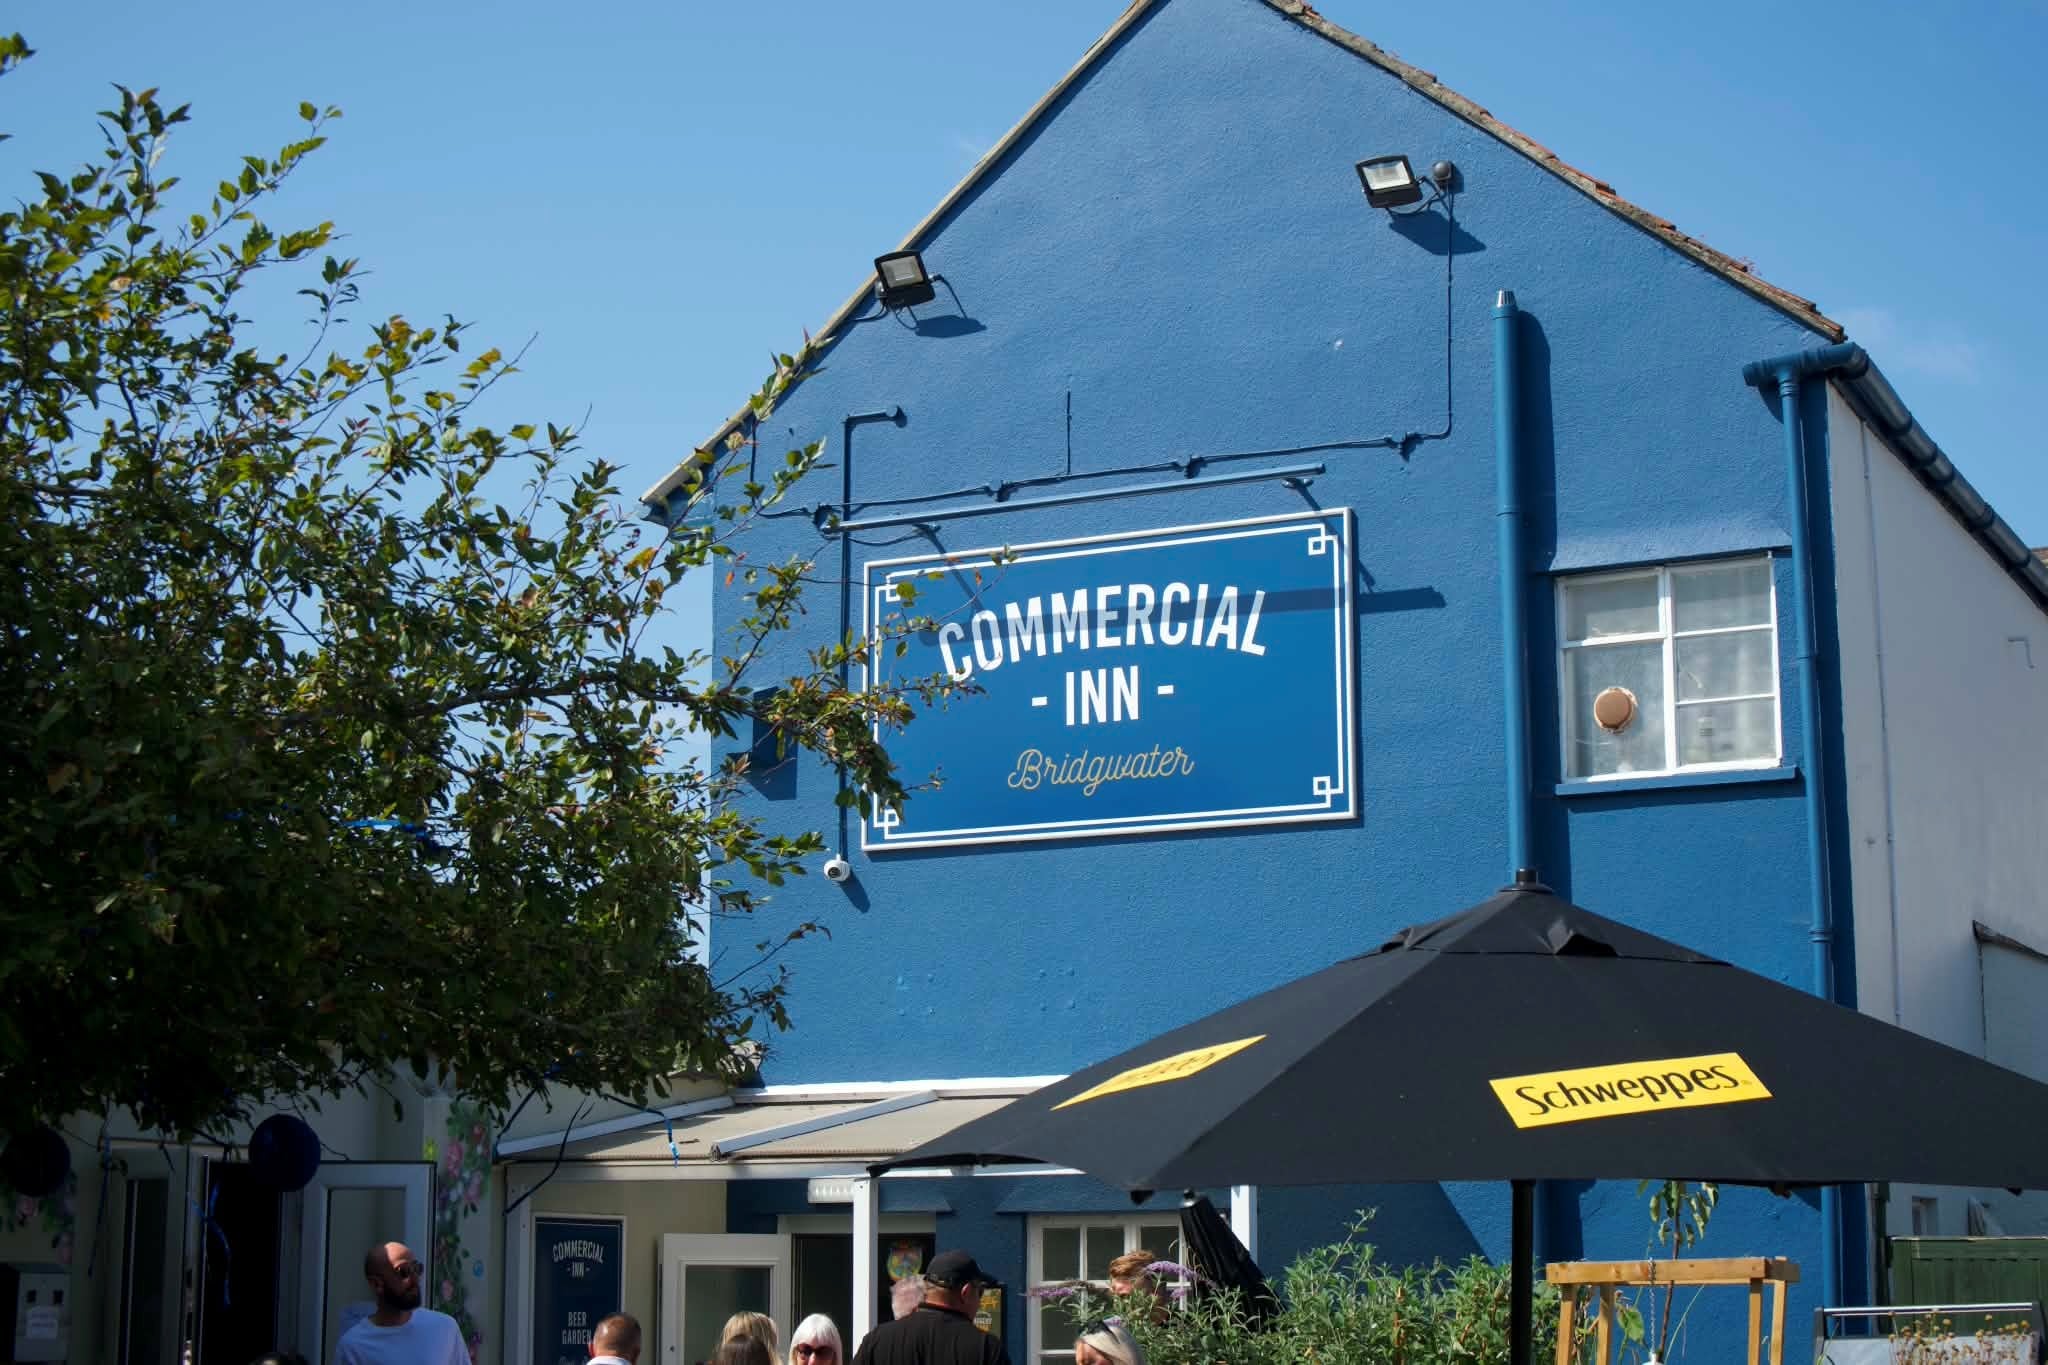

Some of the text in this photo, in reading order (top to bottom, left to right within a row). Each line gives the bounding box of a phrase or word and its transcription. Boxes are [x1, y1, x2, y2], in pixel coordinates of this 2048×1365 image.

[937, 582, 1266, 682] COMMERCIAL
[1065, 665, 1139, 726] INN
[1007, 743, 1195, 797] Bridgwater
[1515, 1065, 1739, 1116] Schweppes
[552, 1239, 604, 1264] COMMERCIAL
[572, 1262, 585, 1276] INN
[561, 1329, 592, 1345] GARDEN
[568, 1311, 587, 1328] BEER
